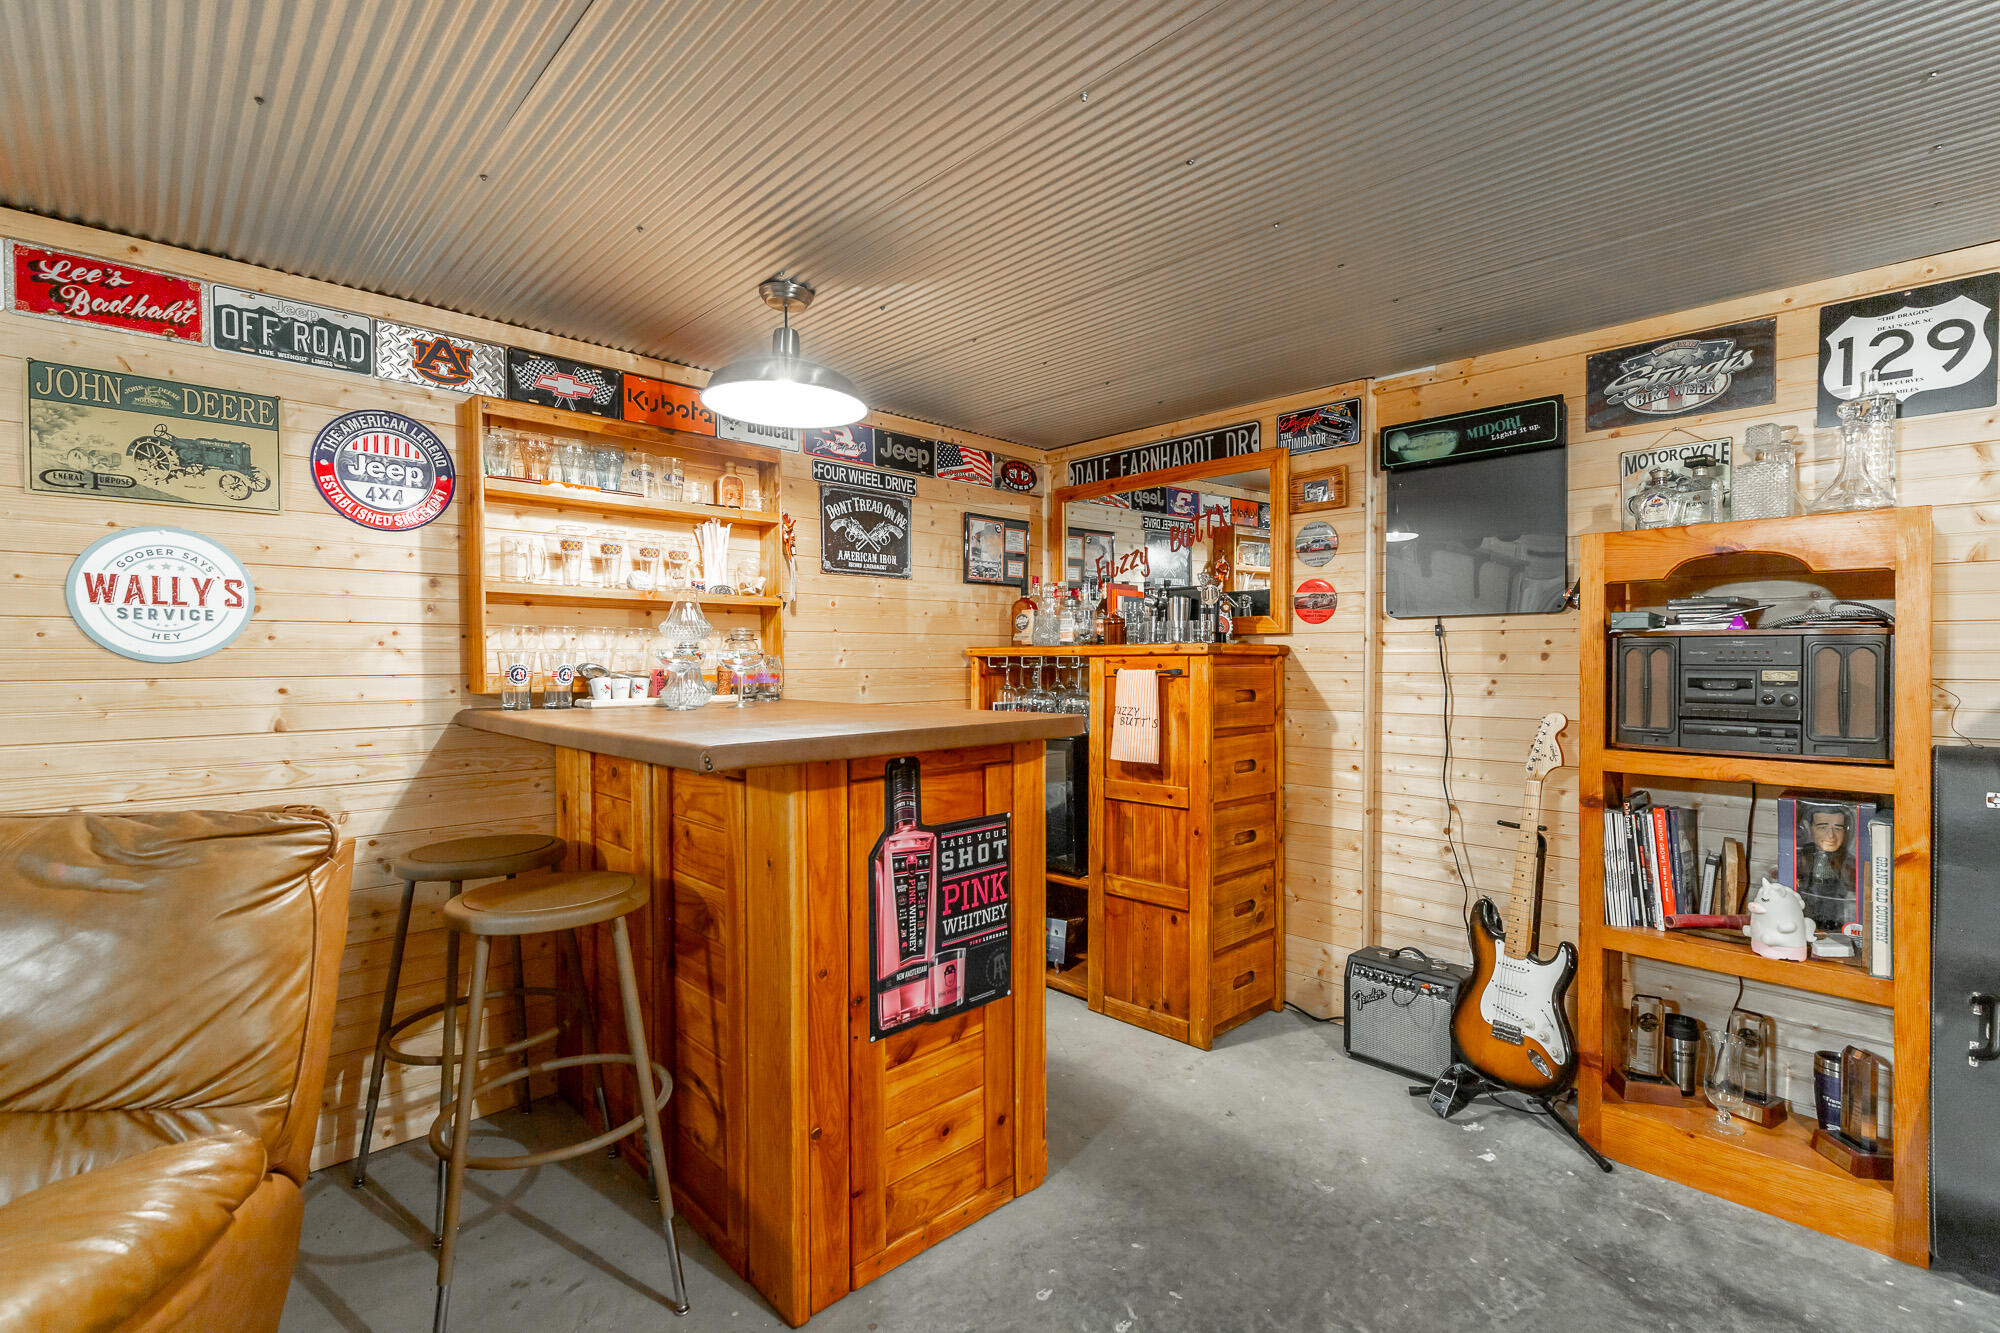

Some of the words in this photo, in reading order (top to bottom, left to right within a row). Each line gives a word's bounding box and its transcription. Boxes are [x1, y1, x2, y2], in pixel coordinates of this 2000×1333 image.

[39, 260, 134, 287] Lee's
[60, 285, 197, 325] Bad-habit
[272, 301, 320, 324] Jeep
[221, 308, 279, 346] OFF
[293, 321, 366, 363] ROAD
[258, 348, 275, 358] LIVE
[277, 352, 308, 363] WITHOUT
[311, 357, 334, 368] LIMITS
[1838, 318, 1976, 387] 129
[1604, 350, 1754, 399] Sturgis
[36, 366, 123, 405] JOHN
[182, 387, 275, 426] DEERE
[628, 387, 714, 424] Kubota
[1635, 386, 1670, 407] BIKE
[1675, 380, 1716, 397] WEEK
[320, 426, 345, 452] THE
[339, 415, 409, 436] AMERICAN
[410, 427, 448, 467] LEGEND
[1280, 431, 1293, 439] THE
[1280, 432, 1326, 450] INTIMIDATOR
[1466, 415, 1521, 440] MIDORI
[1490, 430, 1518, 442] Lights
[1518, 426, 1528, 434] it
[880, 437, 930, 468] Jeep
[1075, 457, 1110, 486] DALE
[1120, 435, 1214, 478] EARNHARDT
[1226, 429, 1249, 457] DR
[347, 454, 424, 487] Jeep
[817, 463, 847, 483] FOUR
[848, 469, 883, 488] WHEEL
[885, 476, 914, 493] DRIVE
[1005, 478, 1034, 490] TIGERS
[319, 475, 393, 526] ESTABLISHED
[394, 505, 432, 527] SINCE
[426, 488, 448, 513] 1941
[365, 486, 404, 505] 4X4
[852, 497, 884, 514] TREAD
[884, 504, 896, 522] ON
[894, 512, 908, 530] ME
[116, 548, 174, 568] GOOBER
[182, 552, 214, 573] SAYS
[837, 550, 878, 563] AMERICAN
[880, 553, 898, 565] IRON
[84, 572, 245, 609] WALLY'S
[116, 607, 215, 621] SERVICE
[151, 632, 181, 640] HEY
[941, 835, 972, 849] TAKE
[977, 828, 1007, 842] YOUR
[941, 838, 1007, 872] SHOT
[1875, 856, 1888, 885] GRAND
[908, 878, 916, 905] PINK
[942, 870, 1008, 916] PINK
[1875, 887, 1888, 904] OLD
[909, 905, 917, 952] WHITNEY
[942, 903, 1008, 936] WHITNEY
[1875, 905, 1888, 944] COUNTRY
[896, 972, 905, 981] NEW
[905, 965, 928, 978] AMSTERDAM
[1352, 989, 1387, 1011] Fender
